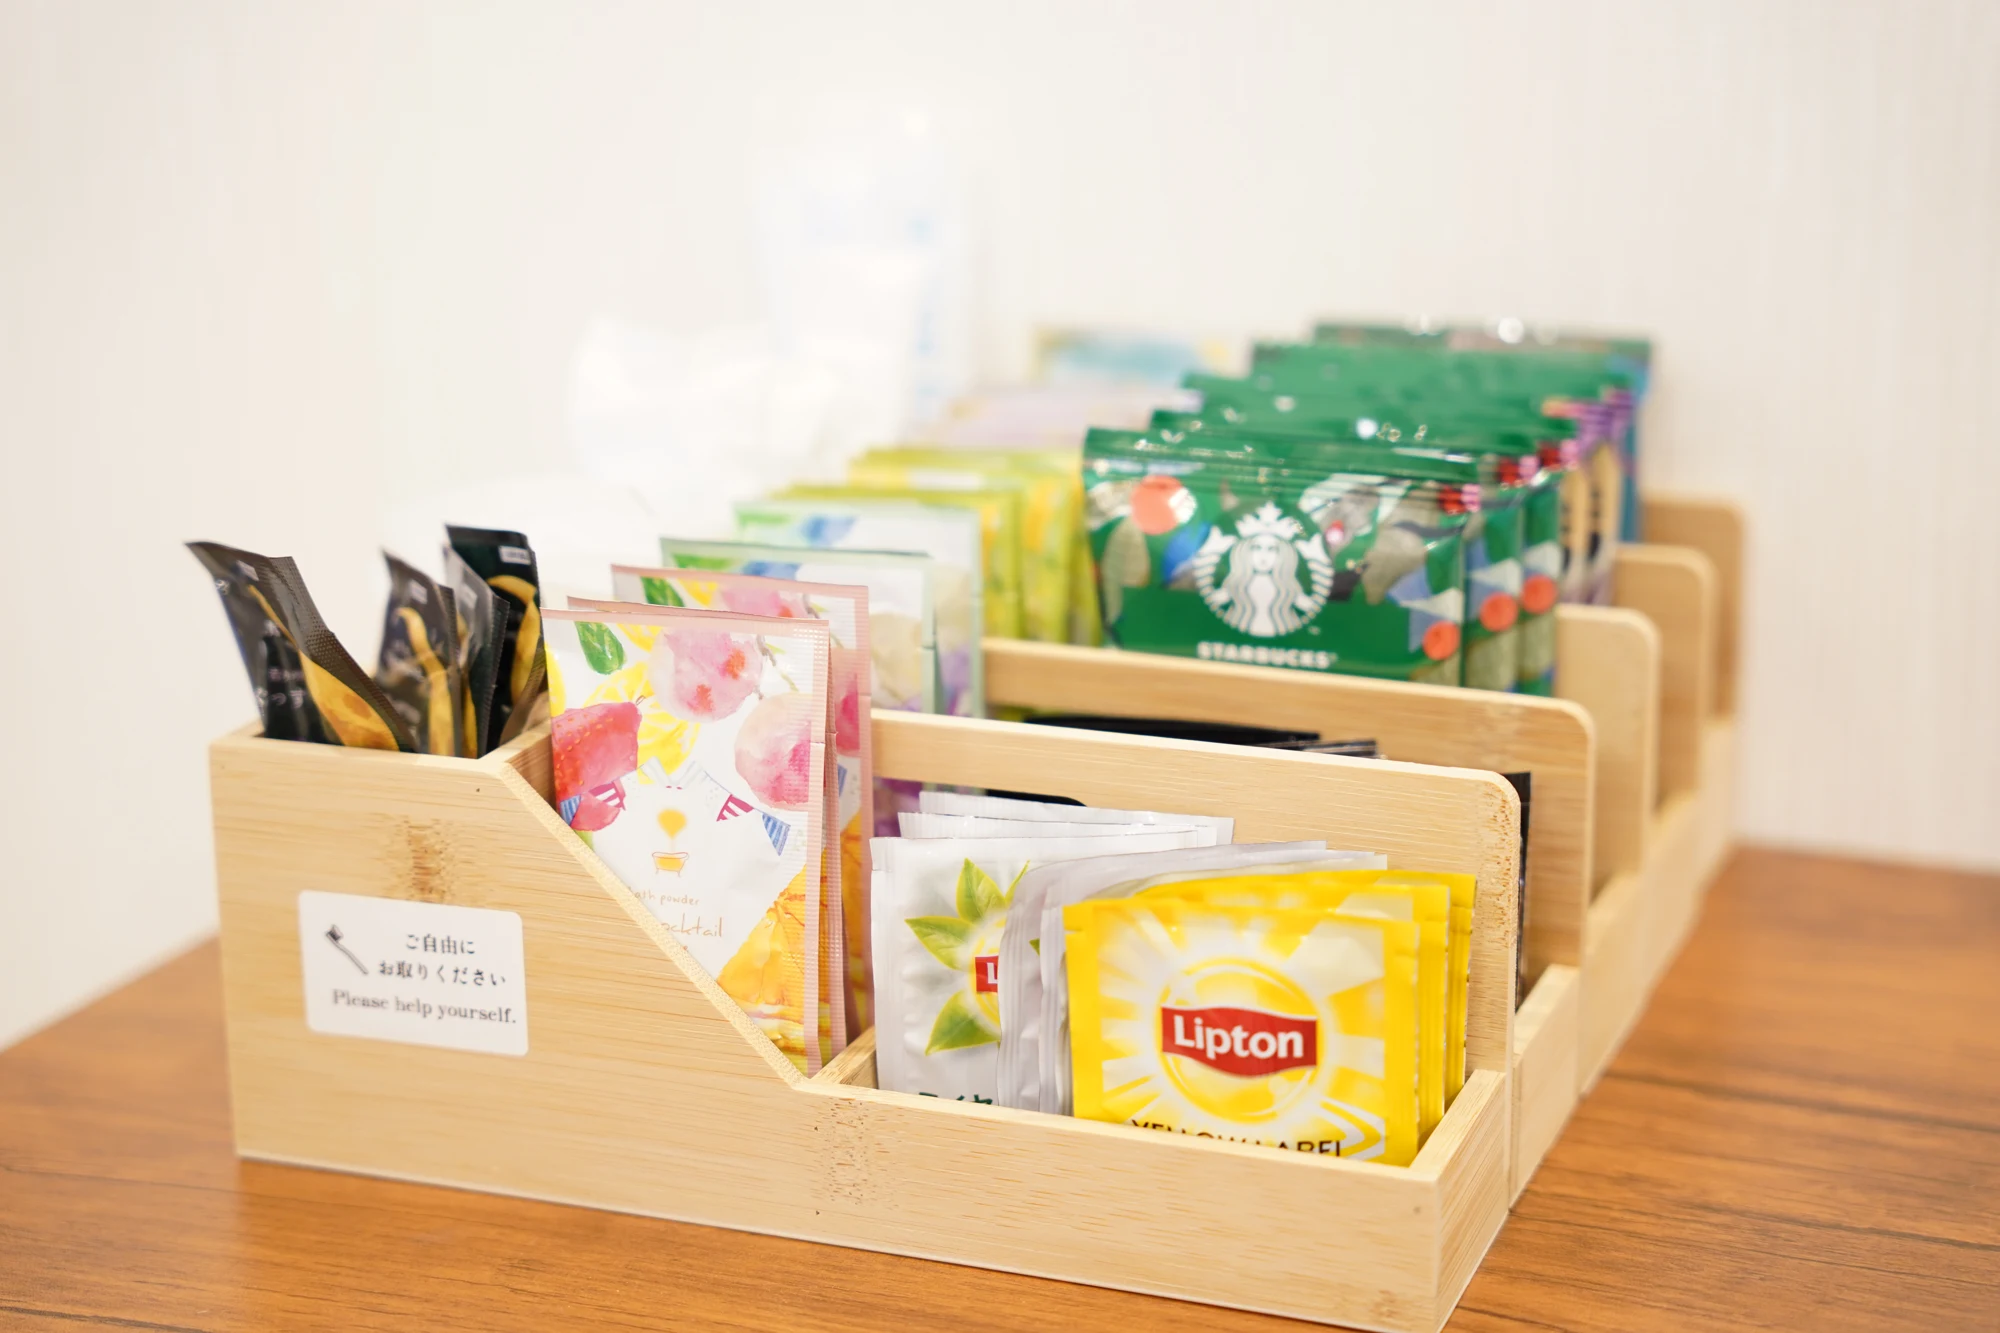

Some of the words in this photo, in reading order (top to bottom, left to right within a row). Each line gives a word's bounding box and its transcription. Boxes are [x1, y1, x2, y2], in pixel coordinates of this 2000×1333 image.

[1197, 641, 1332, 669] STARBUCKS
[660, 894, 701, 906] powder
[660, 912, 723, 938] ocktail
[406, 933, 475, 955] ご自由に
[379, 960, 506, 987] お取りください
[333, 988, 389, 1010] Please
[394, 996, 433, 1019] help
[437, 1004, 517, 1024] yourself.
[1173, 1014, 1304, 1060] Lipton
